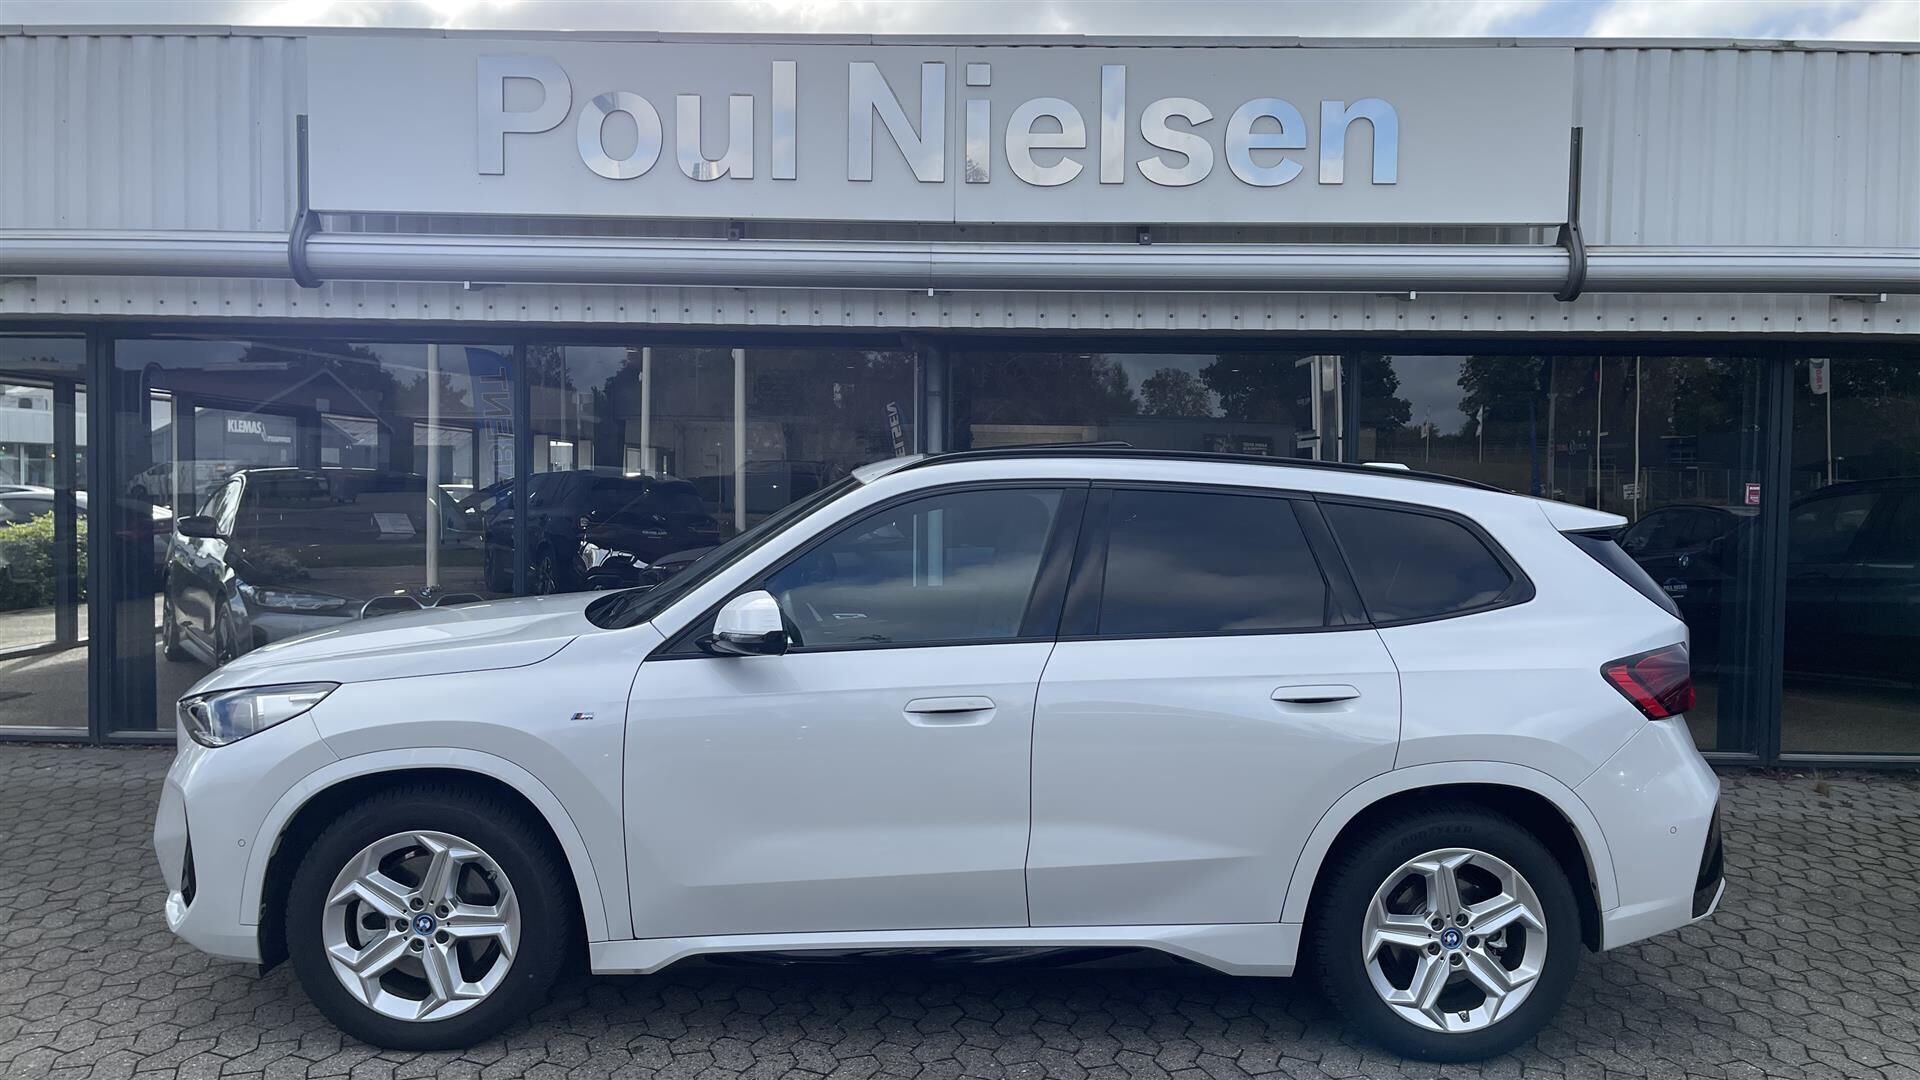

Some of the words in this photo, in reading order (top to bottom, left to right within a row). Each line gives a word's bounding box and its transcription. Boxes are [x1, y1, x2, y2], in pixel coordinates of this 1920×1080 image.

[477, 54, 798, 182] Poul
[847, 61, 1399, 187] Nielsen
[227, 418, 262, 434] KLEMAS
